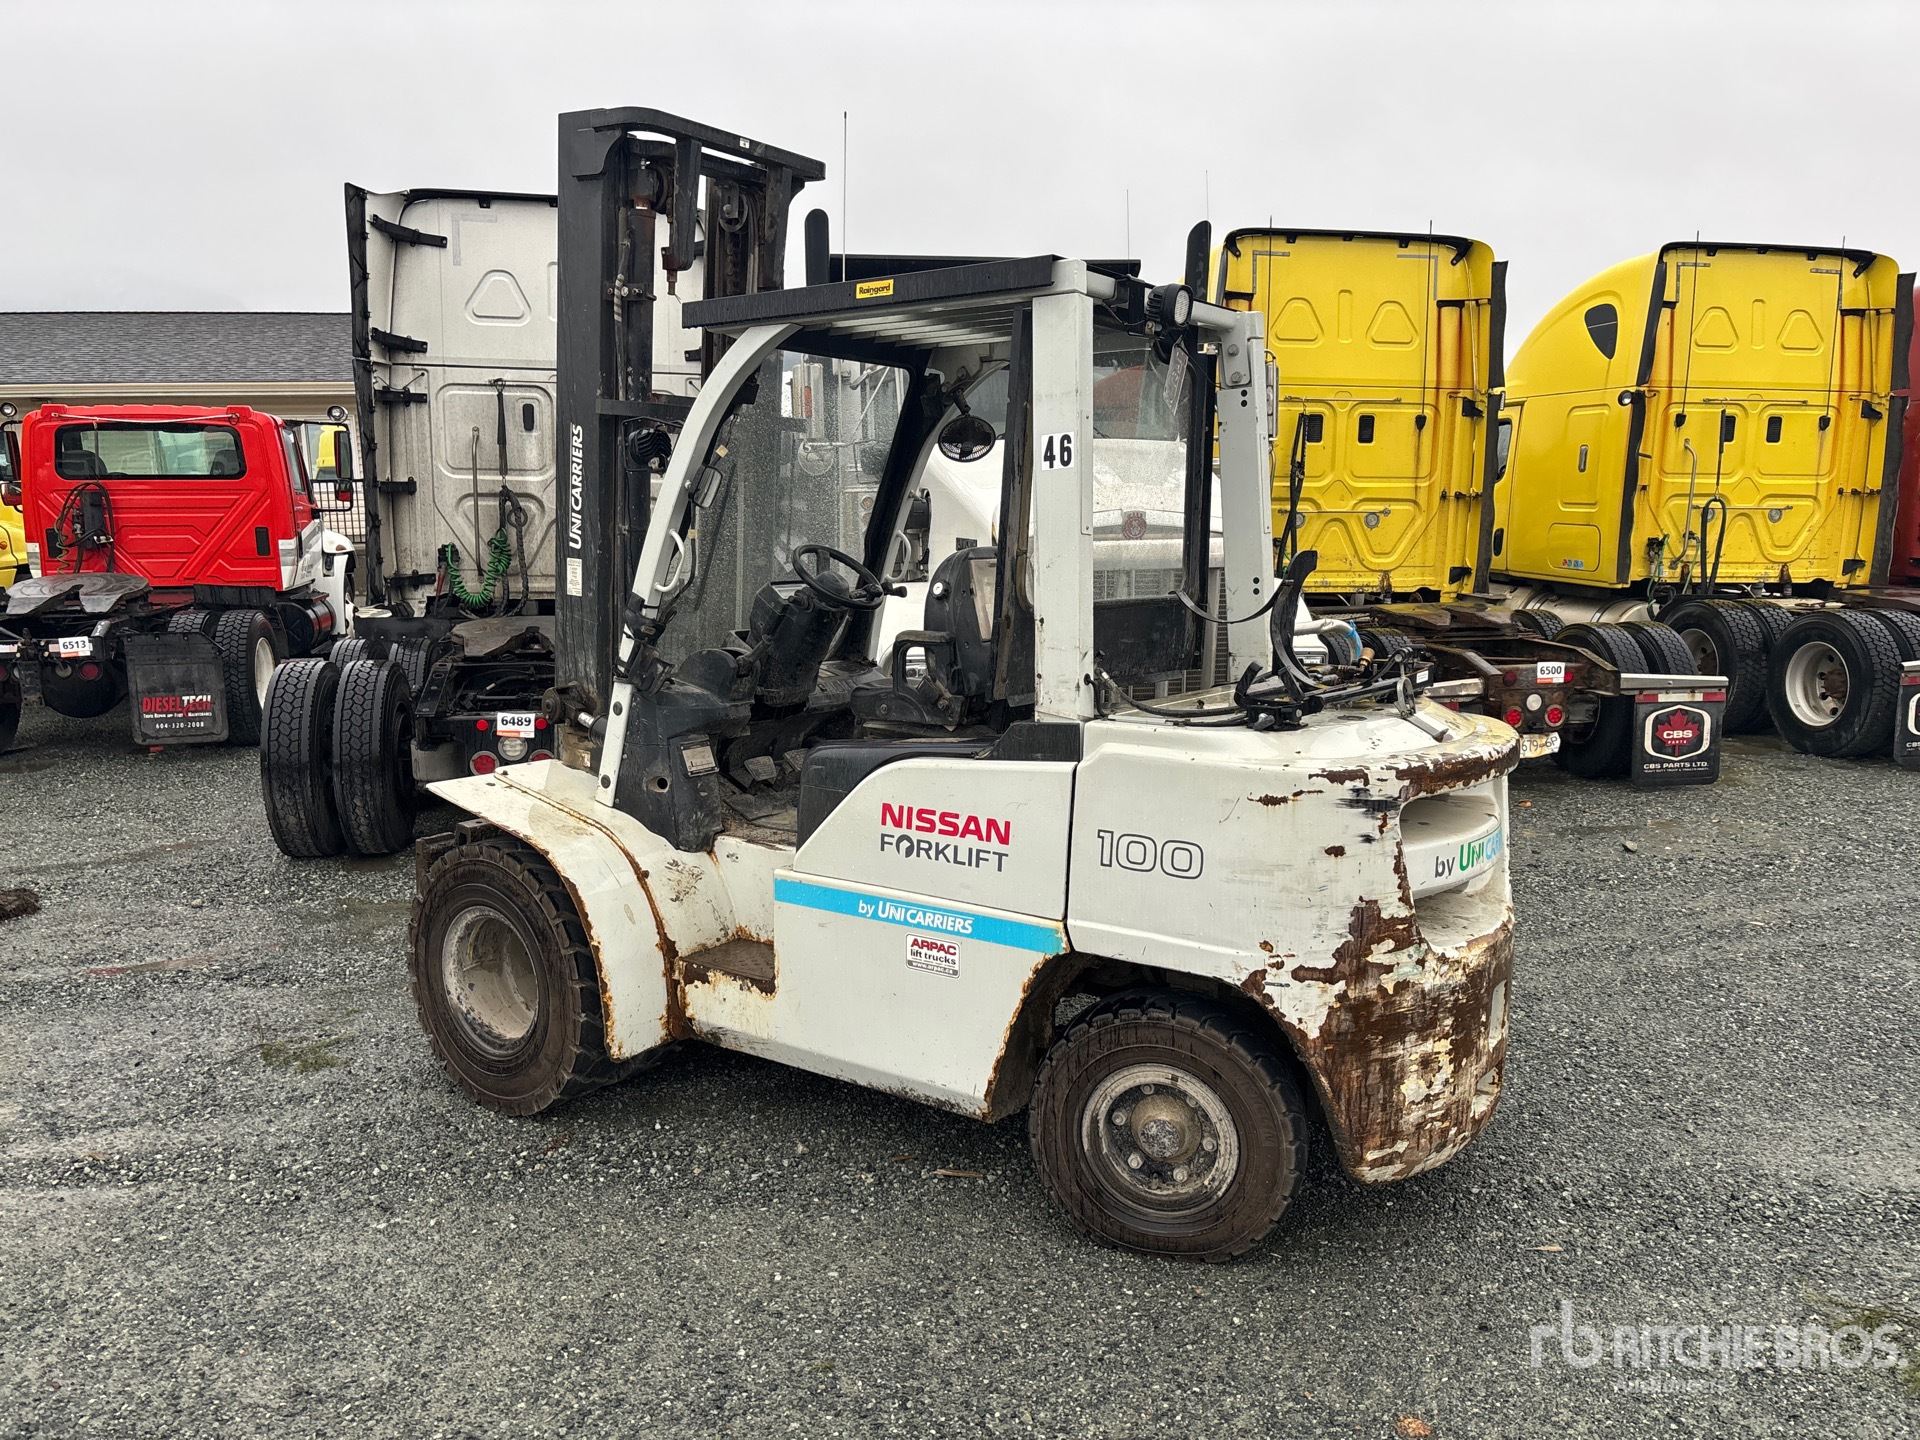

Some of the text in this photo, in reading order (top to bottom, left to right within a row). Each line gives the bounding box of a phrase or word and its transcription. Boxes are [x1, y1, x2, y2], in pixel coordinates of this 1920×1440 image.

[858, 282, 891, 295] Raingard
[1043, 433, 1072, 469] 46
[62, 640, 87, 650] 6513
[1540, 665, 1562, 675] 6500
[501, 715, 532, 727] 6489
[1663, 729, 1693, 739] CBS
[881, 802, 1011, 845] NISSAN
[880, 833, 1009, 873] FORKLIFT
[1097, 829, 1204, 879] 100
[1434, 855, 1455, 879] by
[858, 899, 875, 917] by
[910, 938, 957, 956] ARPAC
[910, 948, 923, 959] lift
[924, 952, 957, 966] trucks
[911, 960, 954, 975] www.arpac.ca
